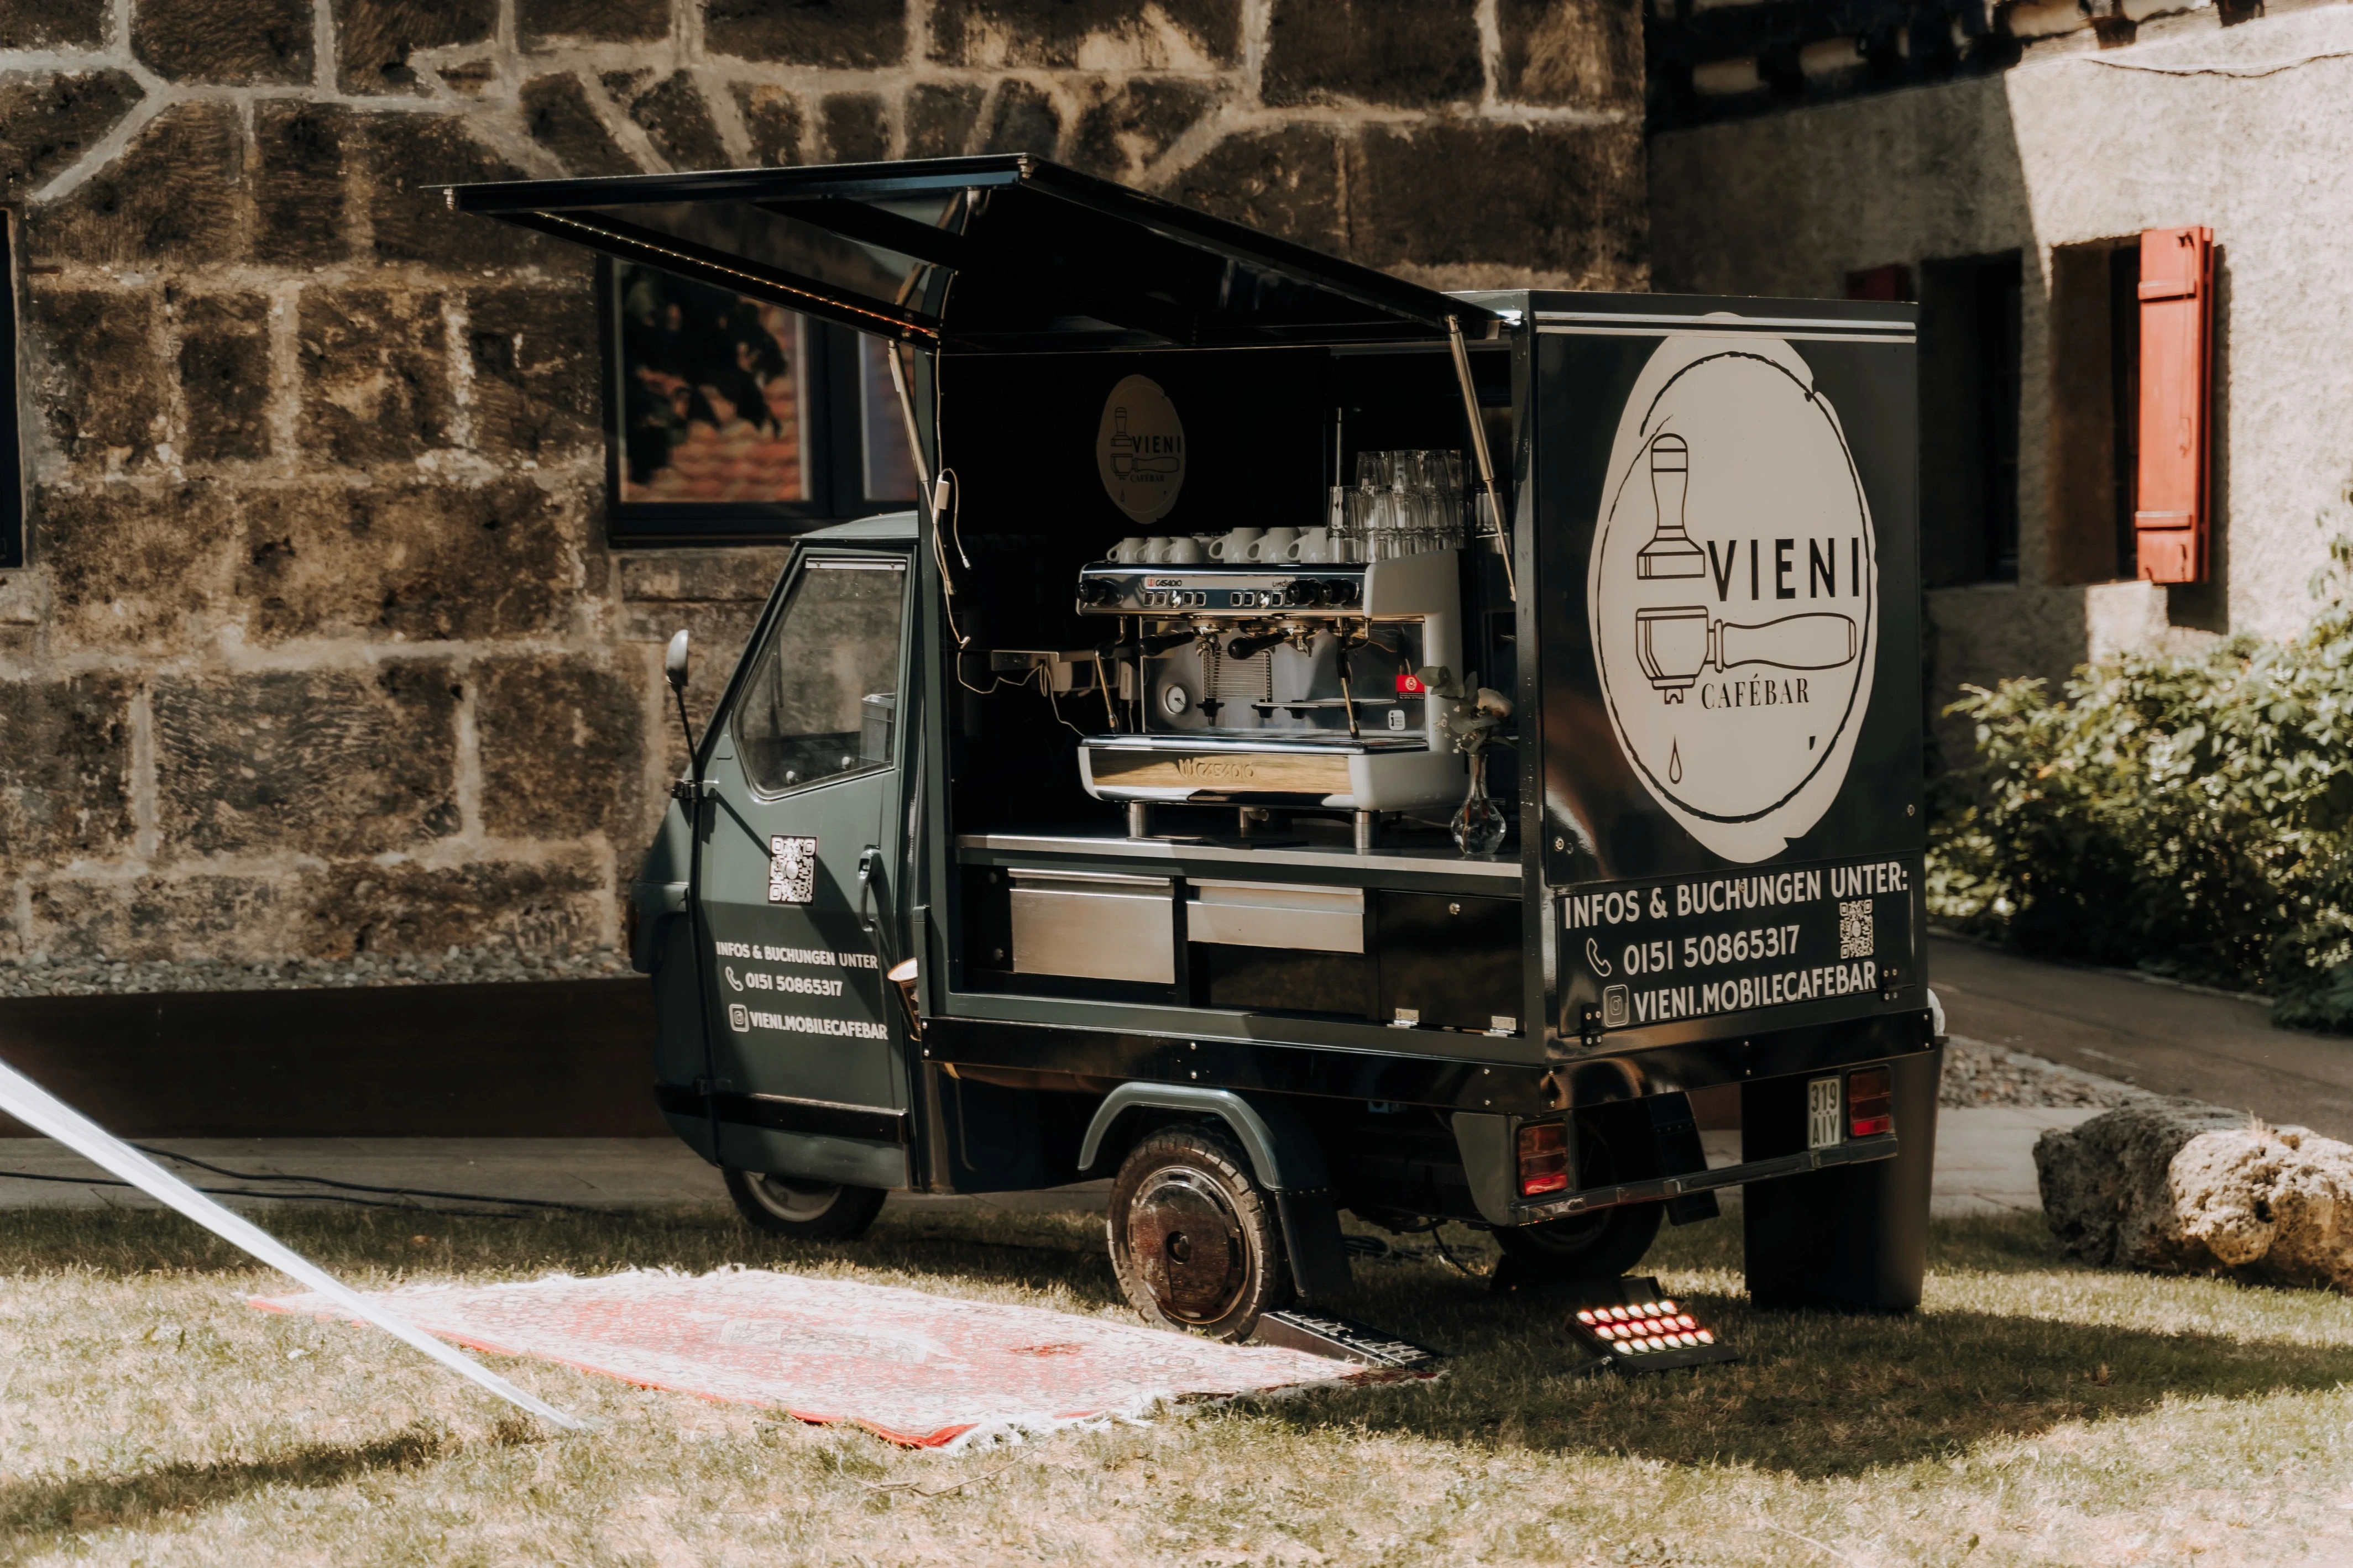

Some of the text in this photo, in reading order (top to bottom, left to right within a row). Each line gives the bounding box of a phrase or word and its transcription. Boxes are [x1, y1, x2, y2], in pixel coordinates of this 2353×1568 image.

[1132, 435, 1181, 453] VIENI
[1706, 537, 1860, 602] VIENI
[1701, 673, 1810, 710] CAFÉBAR
[1564, 861, 1908, 930] INFOS & BUCHUNGEN UNTER:
[715, 941, 879, 969] INFOS & BUCHUNGEN UNTER
[1623, 924, 1801, 976] 0151 50865317
[744, 972, 844, 997] 0151 50865317
[1633, 960, 1878, 1023] VIENI.MOBILECAFEBAR
[748, 1010, 890, 1041] VIENI.MOBILECAFEBAR
[1811, 1081, 1838, 1113] 319
[1811, 1114, 1838, 1146] AIY
